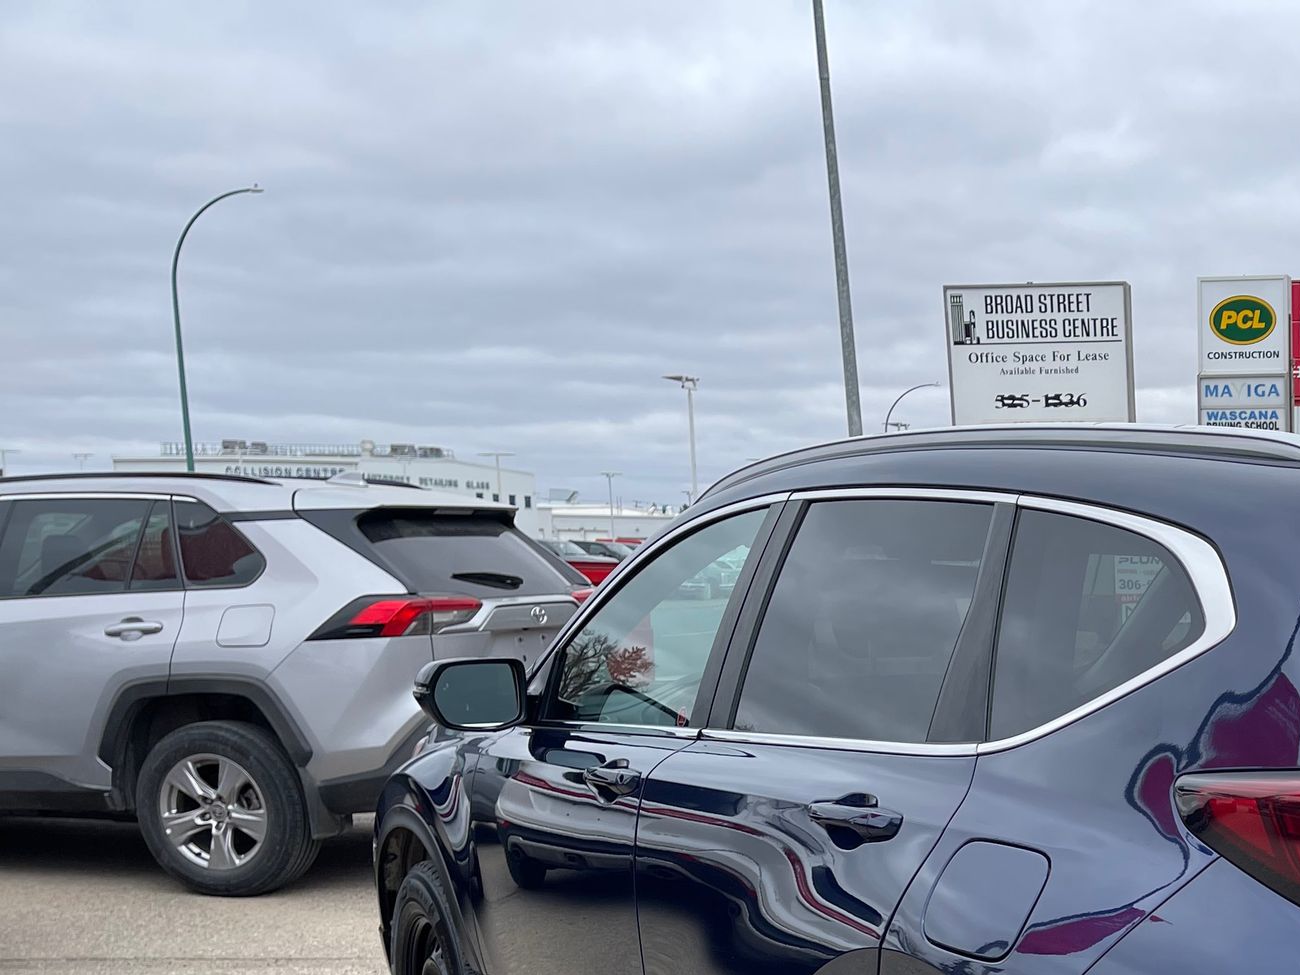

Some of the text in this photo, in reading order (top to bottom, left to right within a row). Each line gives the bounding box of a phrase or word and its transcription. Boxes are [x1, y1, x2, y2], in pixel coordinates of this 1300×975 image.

[984, 293, 1092, 314] BROAD STREET
[1220, 309, 1266, 329] PCL
[985, 317, 1119, 340] BUSINESS CENTRE
[968, 350, 1110, 365] Office Space For Lease
[1207, 350, 1280, 360] CONSTRUCTION
[1039, 366, 1080, 375] Furnished
[1206, 410, 1280, 421] WASCANA
[1244, 420, 1280, 431] SCHOOL
[225, 465, 292, 477] COLLISION
[418, 476, 459, 488] DETAILING
[465, 480, 490, 490] GLASS
